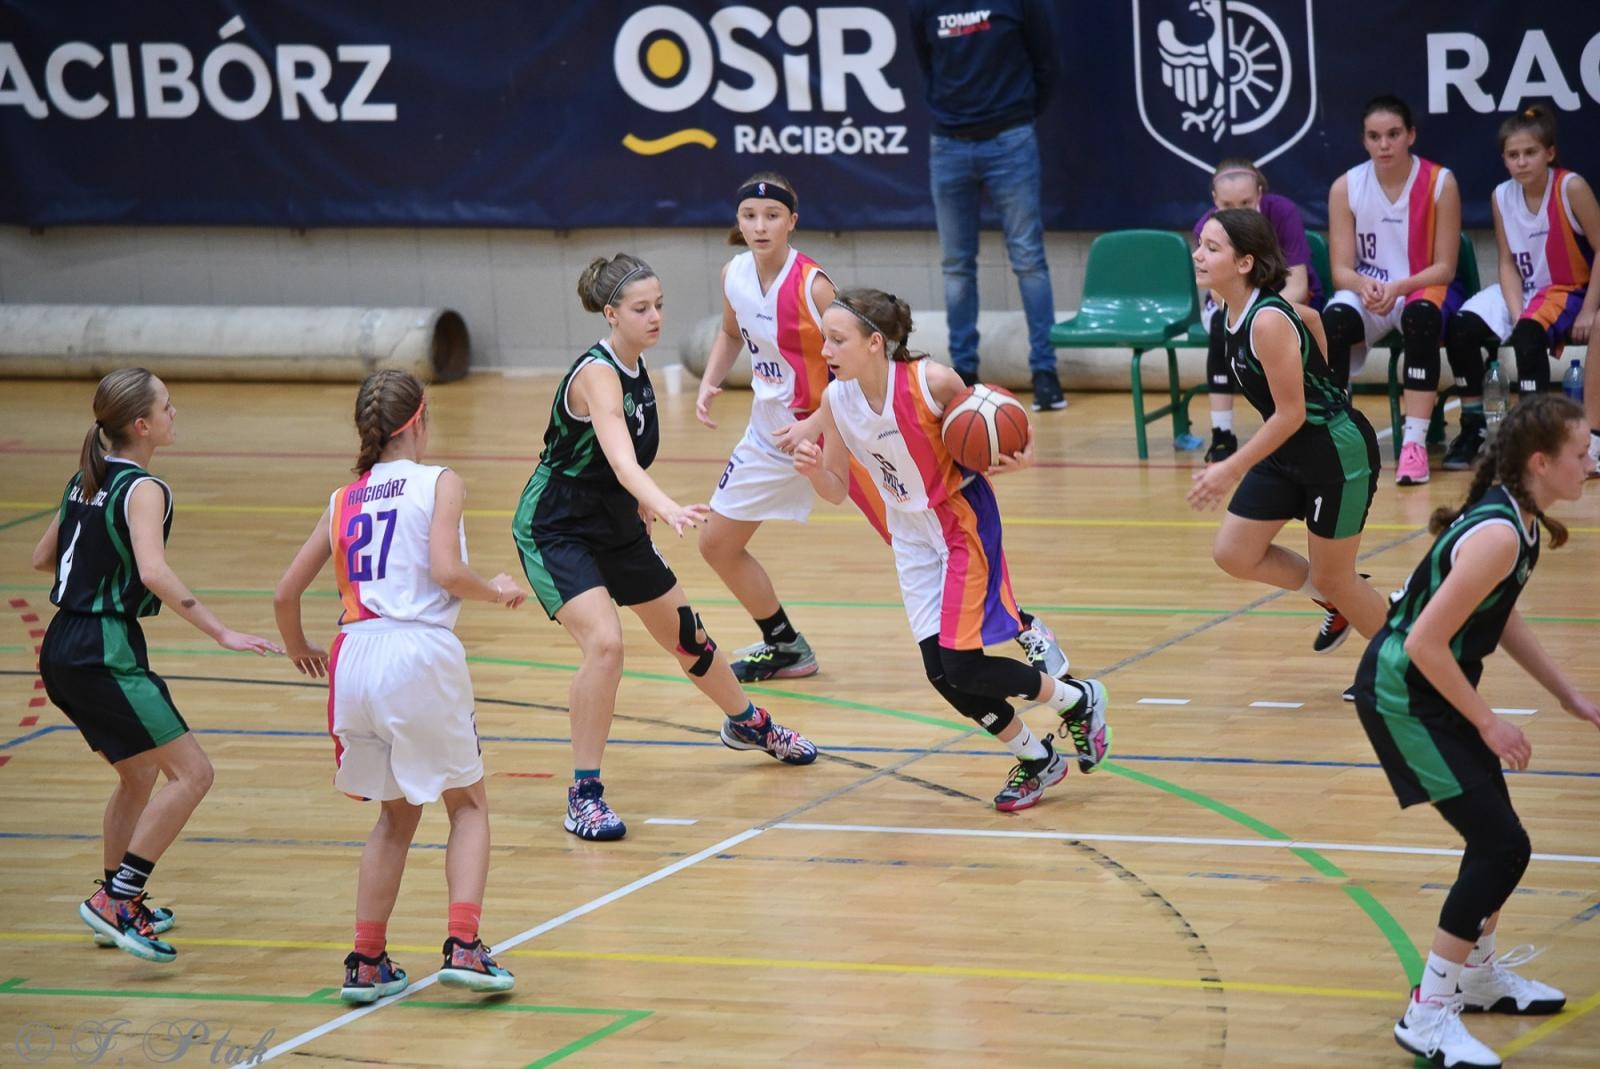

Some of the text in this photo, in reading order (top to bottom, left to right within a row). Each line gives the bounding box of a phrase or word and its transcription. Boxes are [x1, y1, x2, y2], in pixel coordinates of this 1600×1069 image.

[937, 10, 991, 29] TOMMY
[734, 117, 909, 155] RACIBÓRZ
[1358, 232, 1376, 260] 13
[719, 461, 734, 490] 6
[348, 478, 407, 506] RACIBÓRZ
[1314, 495, 1323, 523] 1
[346, 508, 398, 583] 27
